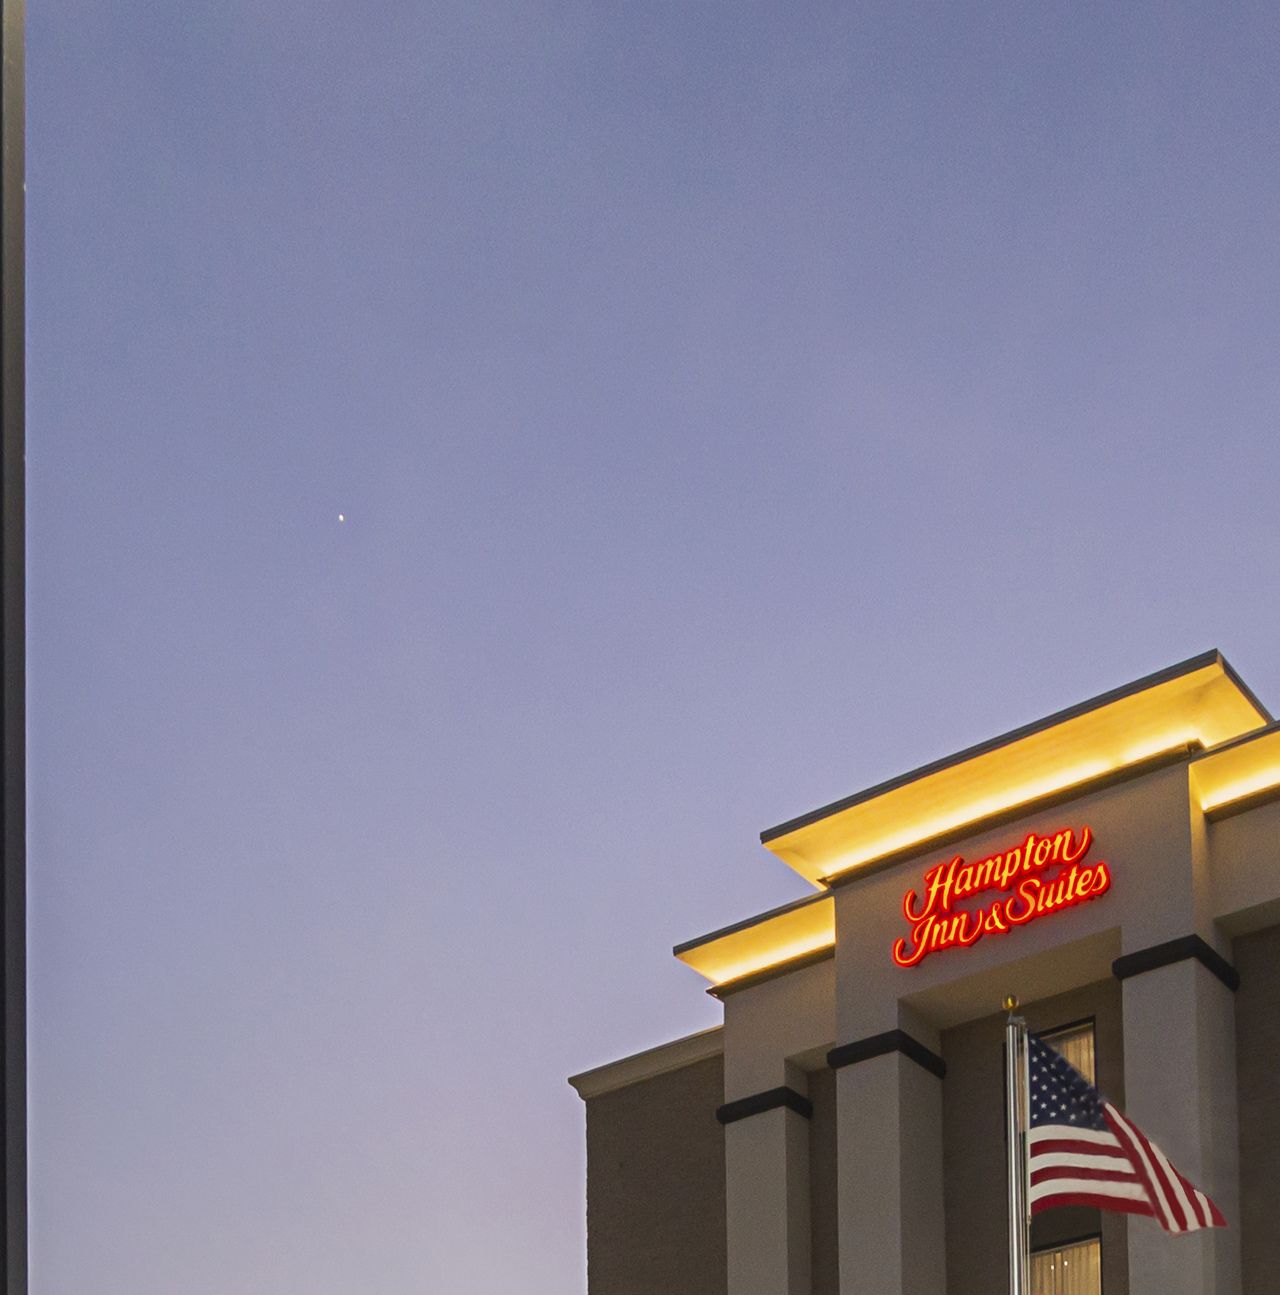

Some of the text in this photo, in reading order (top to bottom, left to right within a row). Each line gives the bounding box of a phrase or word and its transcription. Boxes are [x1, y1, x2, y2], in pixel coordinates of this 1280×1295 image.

[893, 862, 1110, 967] Inn & Suites
[903, 825, 1093, 923] Hampton
